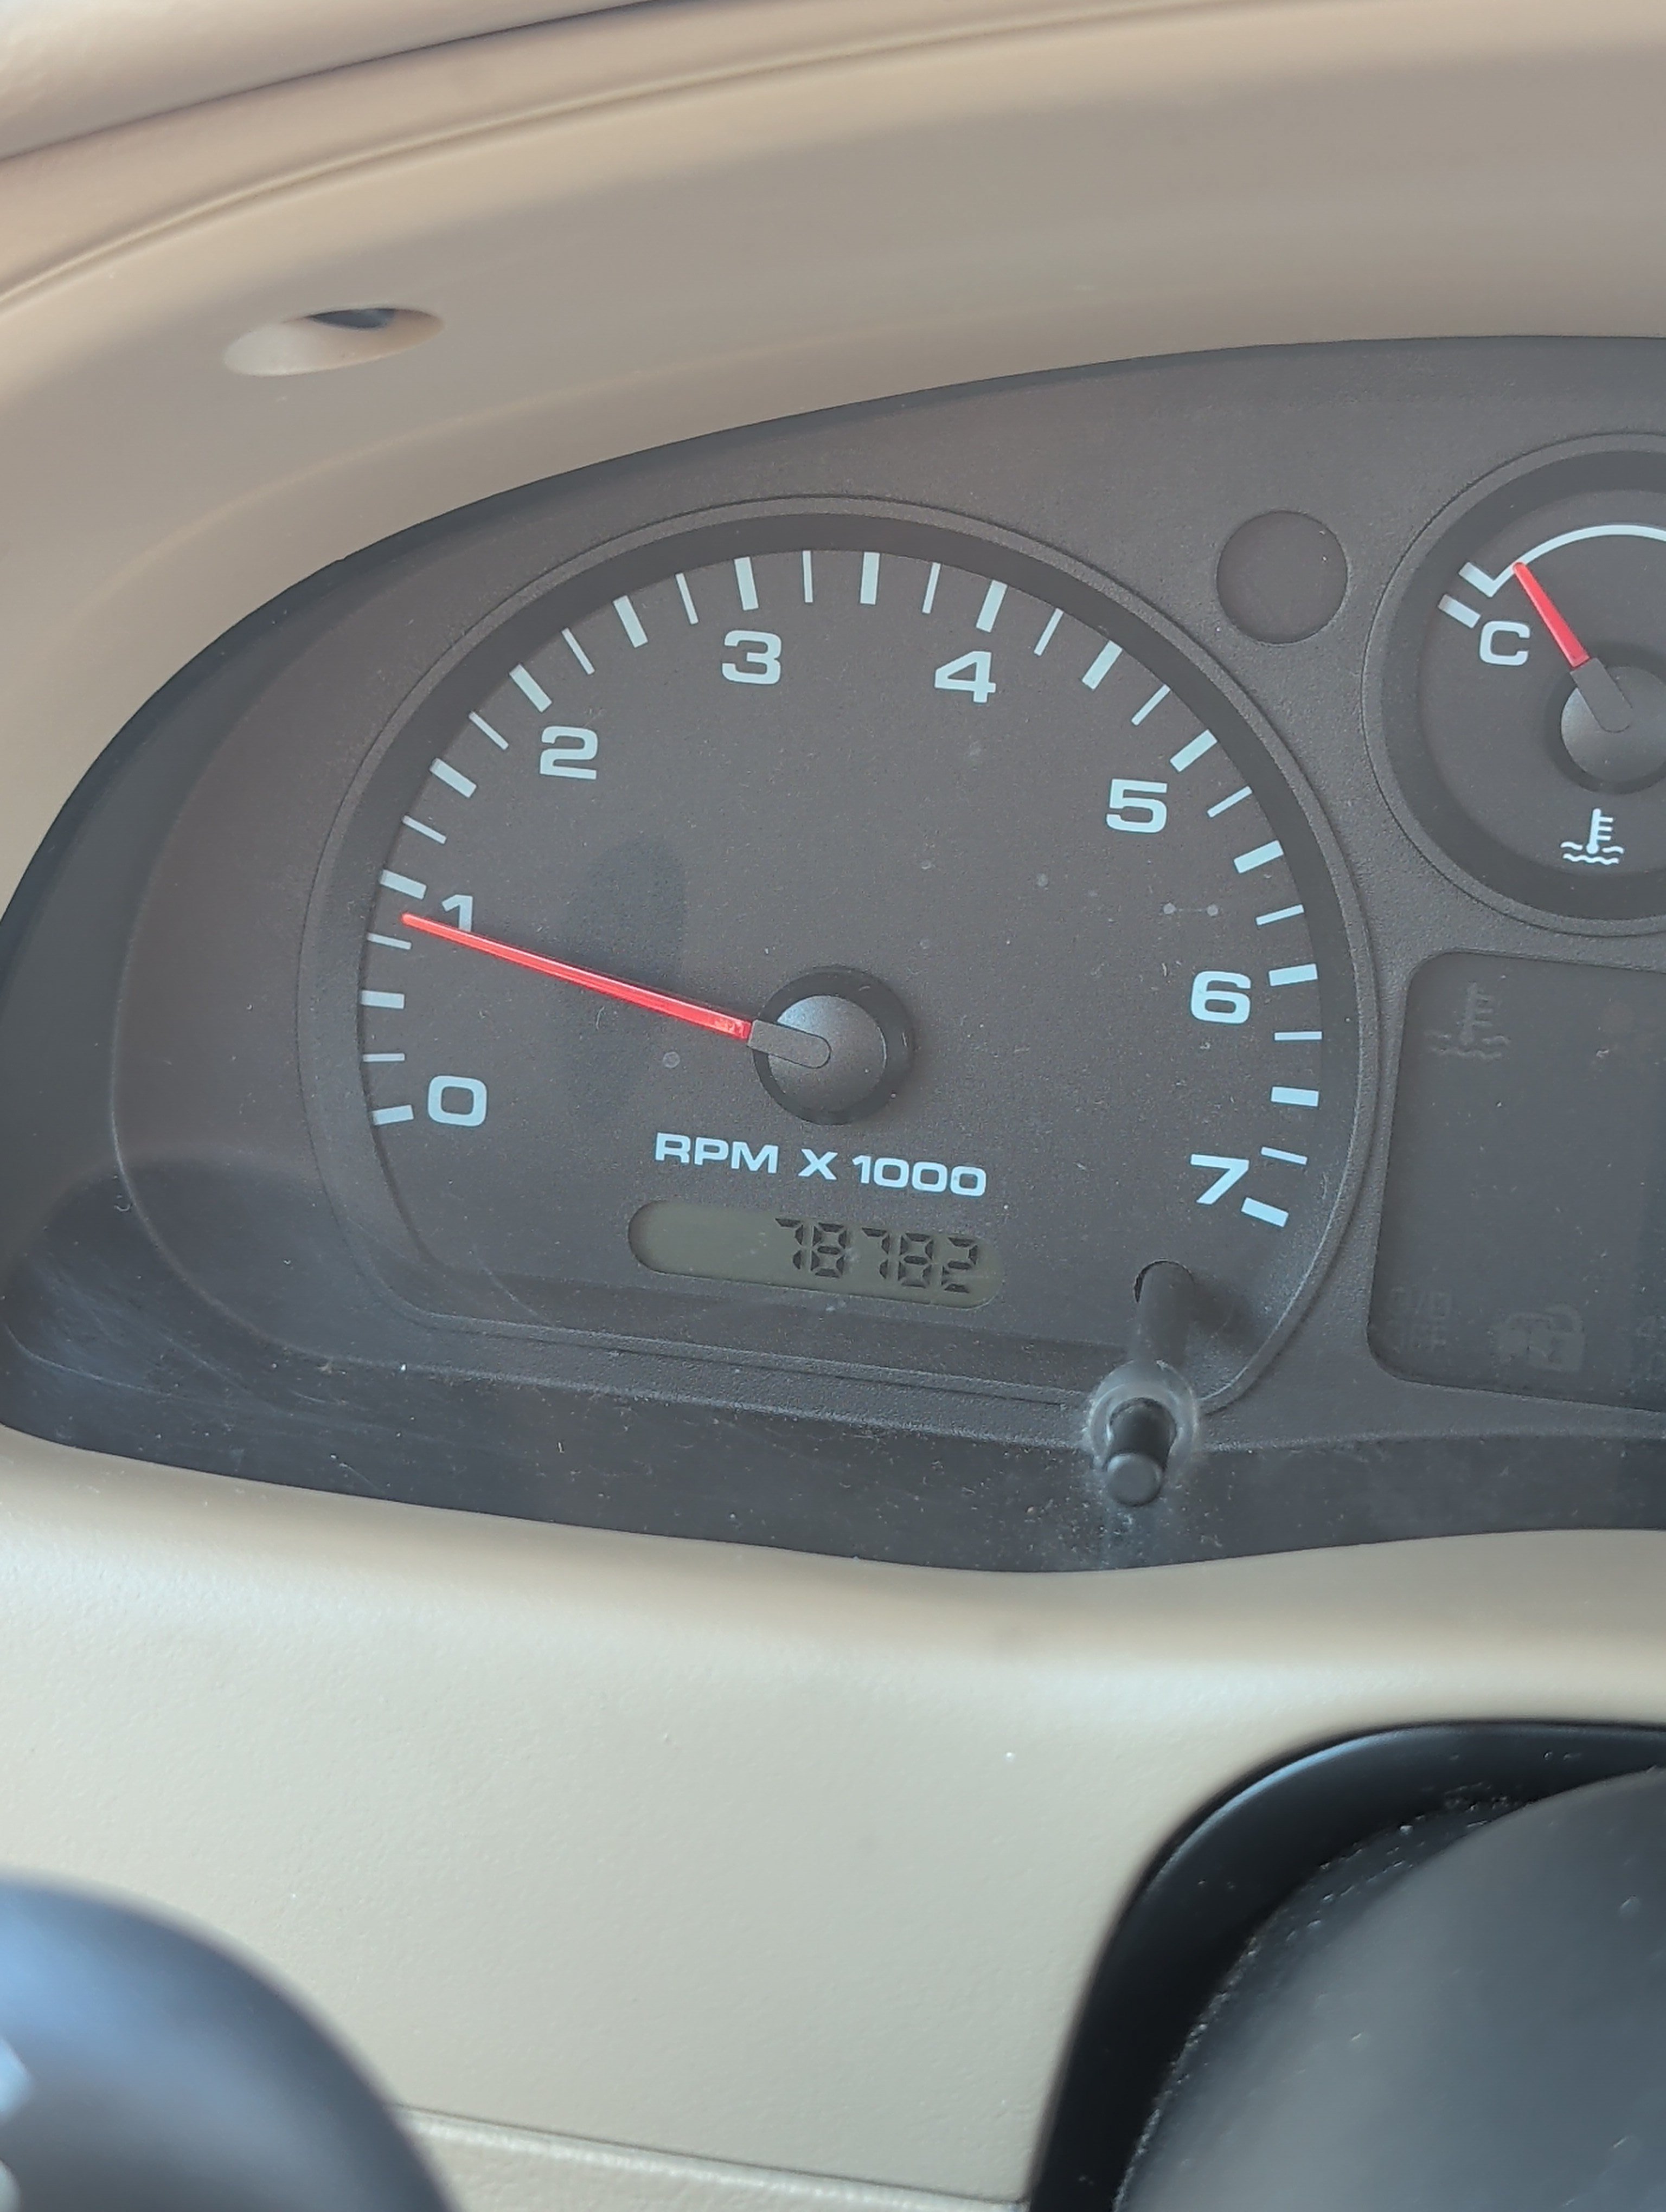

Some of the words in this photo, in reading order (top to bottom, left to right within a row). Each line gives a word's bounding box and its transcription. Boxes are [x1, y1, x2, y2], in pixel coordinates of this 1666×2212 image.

[722, 629, 782, 685] 3
[1479, 620, 1531, 666] C
[934, 650, 997, 703] 4
[539, 725, 598, 780] 2
[1106, 778, 1168, 833] 5
[441, 894, 473, 933] 1
[1190, 970, 1251, 1024] 6
[427, 1075, 488, 1127] 0
[655, 1132, 779, 1174] RPM
[798, 1148, 838, 1181] X
[851, 1154, 988, 1197] 1000
[1190, 1153, 1250, 1206] 7
[774, 1217, 979, 1294] 78782
